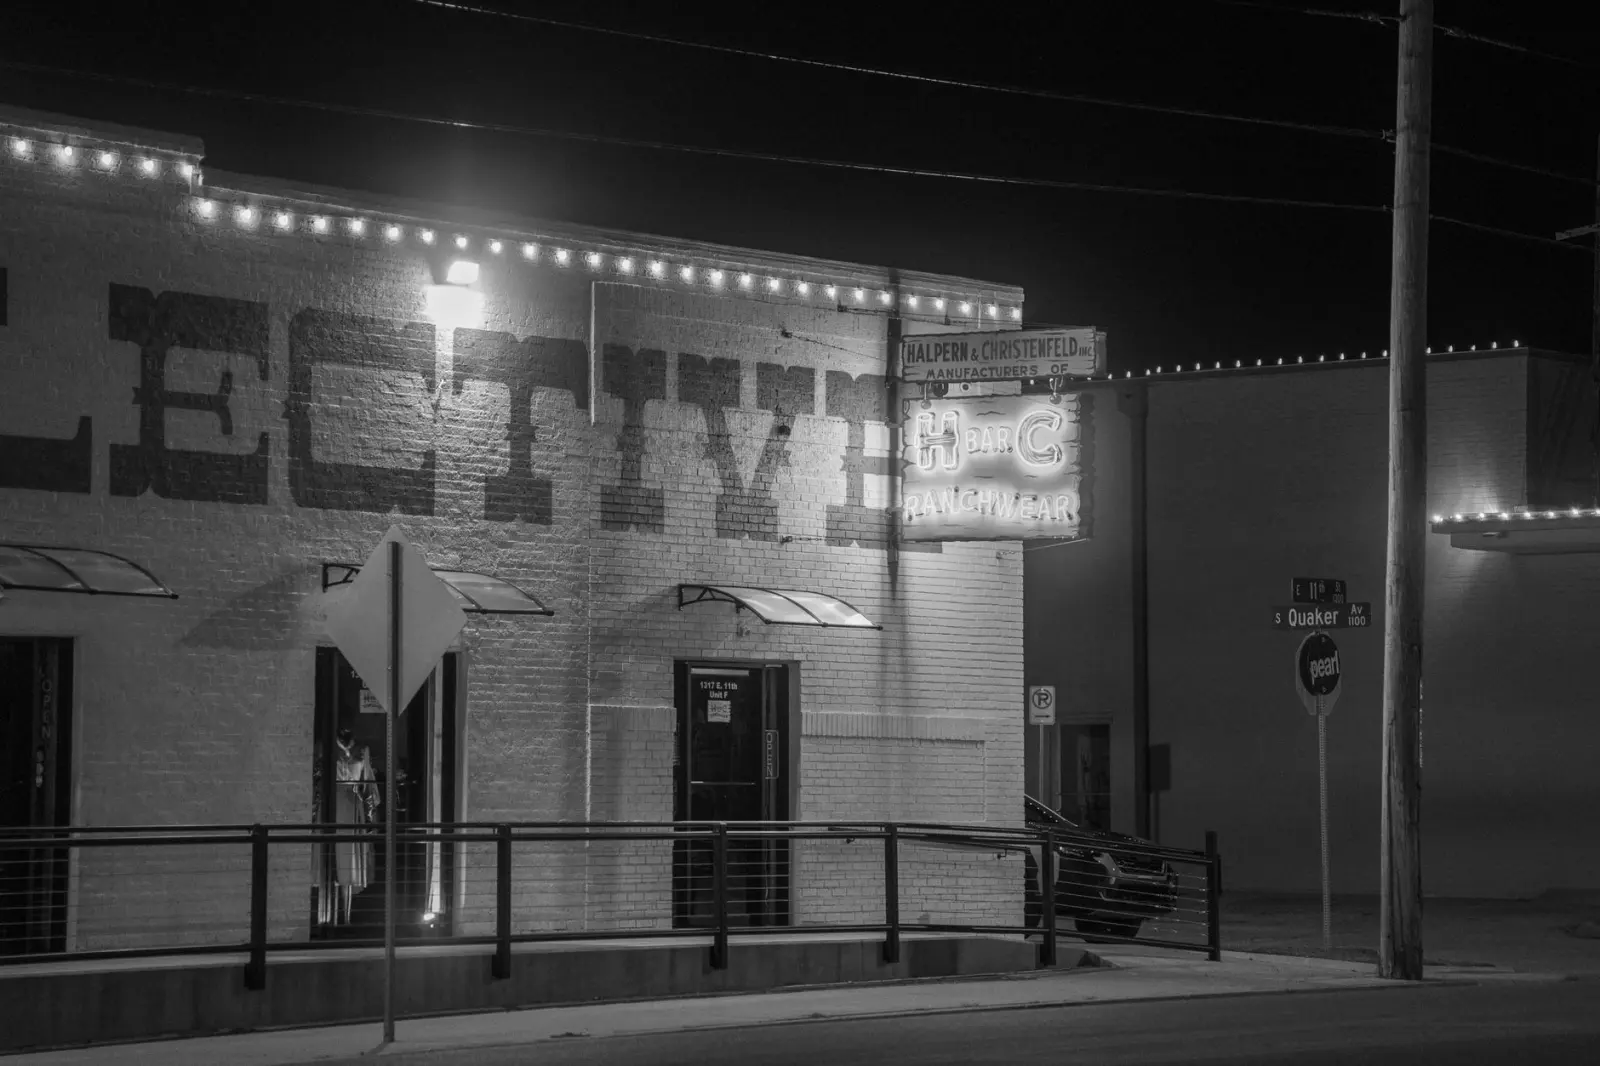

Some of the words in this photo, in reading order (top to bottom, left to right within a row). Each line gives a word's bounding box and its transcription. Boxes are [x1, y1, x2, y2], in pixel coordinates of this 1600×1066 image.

[906, 341, 968, 364] HALPERN
[971, 350, 979, 362] &
[981, 336, 1077, 361] CHRISTENFELD
[926, 365, 1039, 379] MANUFACTURERS
[1051, 364, 1069, 375] OF
[914, 410, 960, 470] H
[965, 426, 1013, 454] BAR
[1016, 410, 1063, 467] C
[905, 487, 1077, 521] RANCHWEAR
[1296, 584, 1301, 596] E
[1275, 612, 1281, 624] S
[1288, 606, 1339, 627] Quaker
[1350, 604, 1363, 614] Av
[1348, 616, 1366, 626] 1100
[1310, 650, 1340, 685] pearl
[700, 681, 715, 690] 1317
[724, 682, 738, 690] 11th
[709, 691, 723, 699] Unit
[41, 679, 52, 739] OPEN
